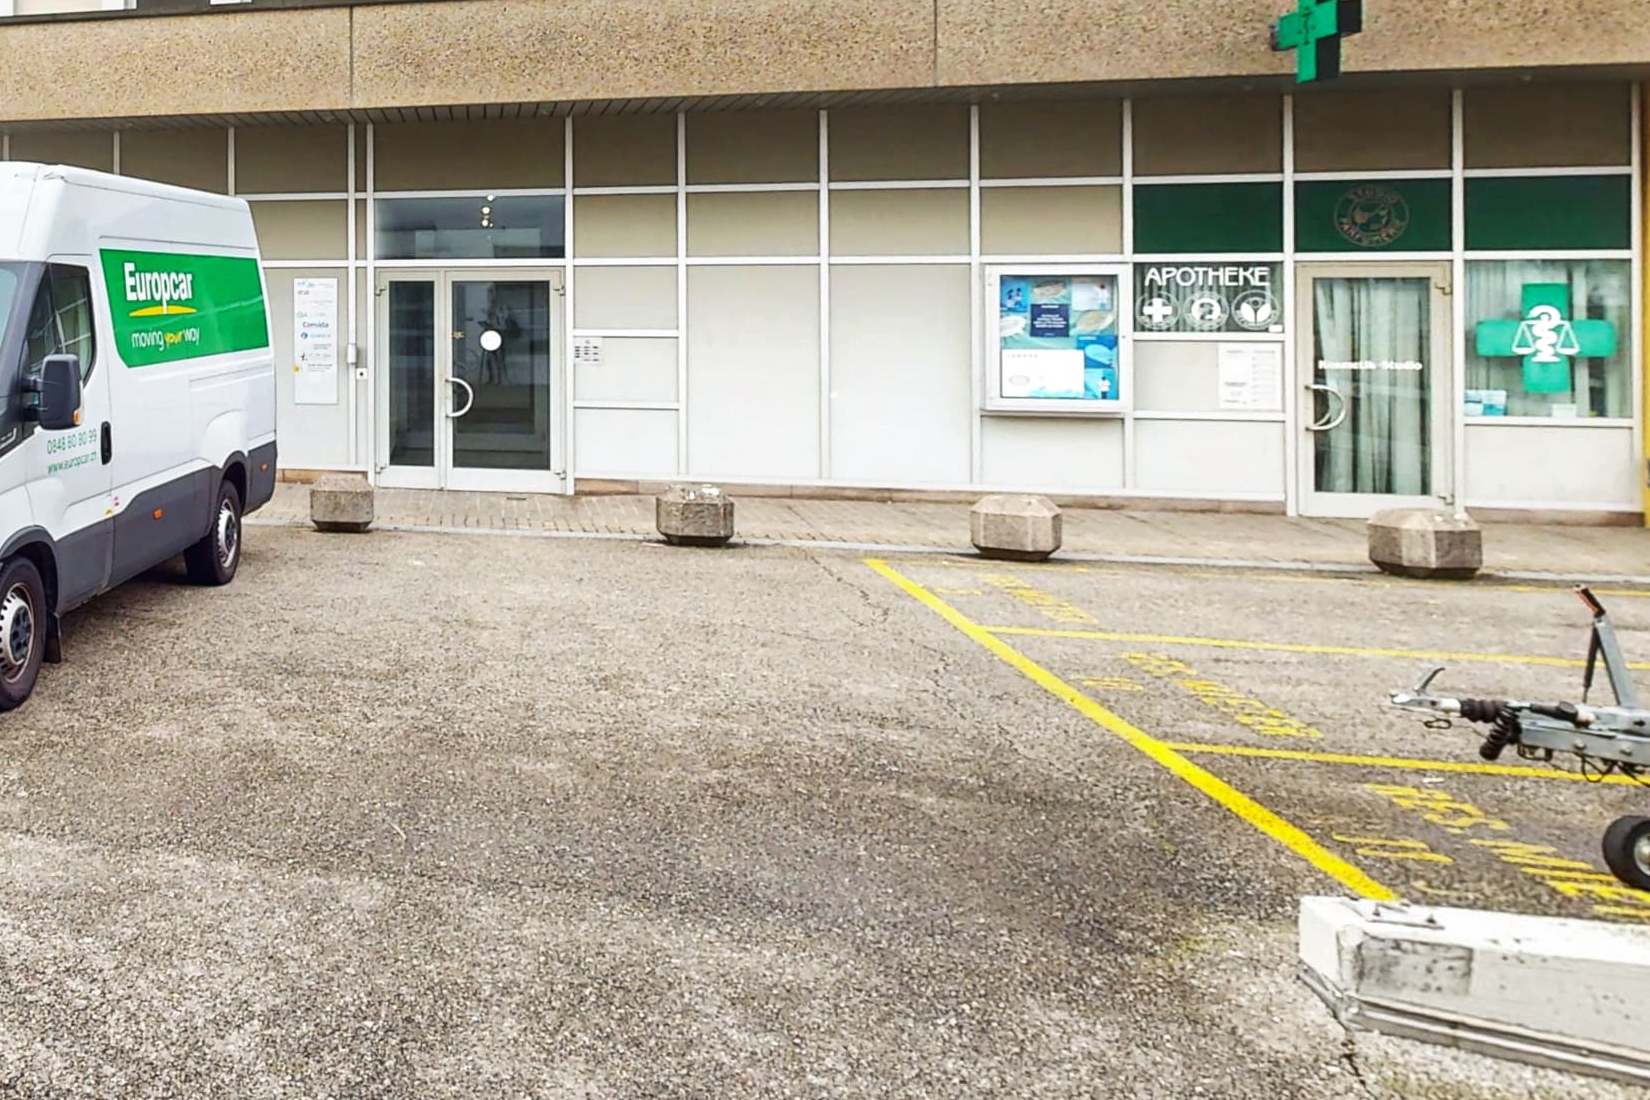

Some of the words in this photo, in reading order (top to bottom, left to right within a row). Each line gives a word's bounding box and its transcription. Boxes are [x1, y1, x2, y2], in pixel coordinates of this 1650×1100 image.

[123, 262, 194, 315] Europcar
[1144, 266, 1270, 287] APOTHEKE
[131, 330, 164, 351] moving
[165, 330, 184, 348] your
[183, 327, 200, 346] way
